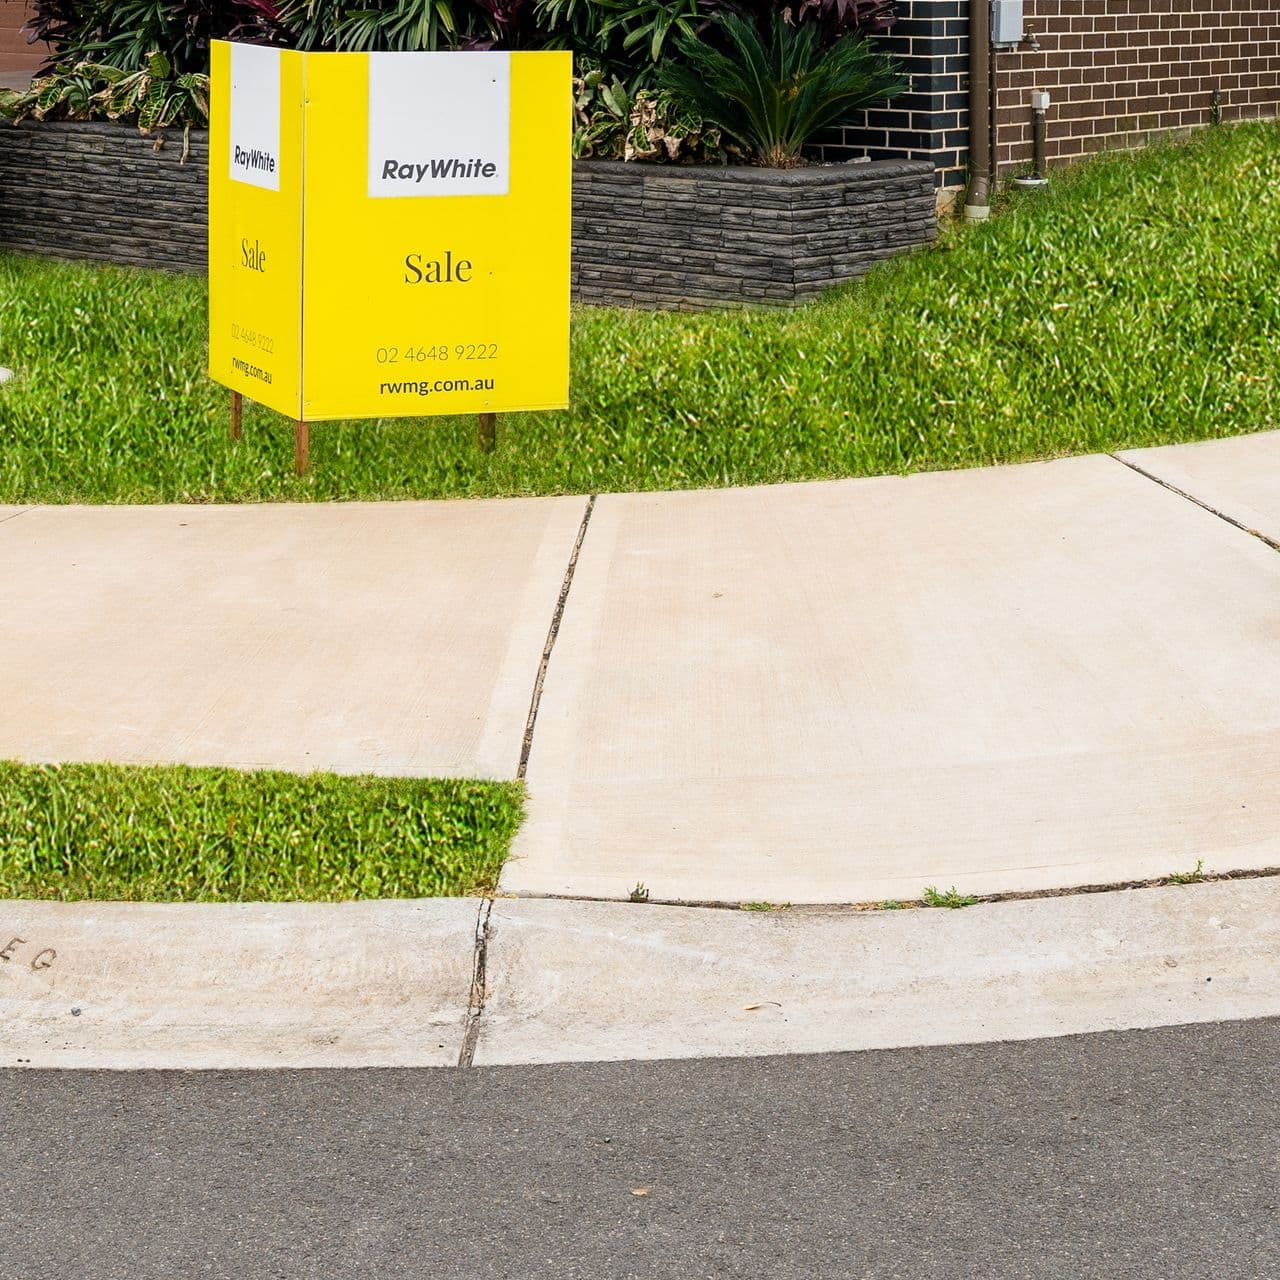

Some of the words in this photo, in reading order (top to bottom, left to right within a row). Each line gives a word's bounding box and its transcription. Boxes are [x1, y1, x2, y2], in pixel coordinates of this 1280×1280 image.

[241, 237, 266, 273] Sale
[404, 250, 473, 284] Sale
[231, 322, 240, 340] 02
[376, 347, 399, 364] 02
[404, 345, 449, 362] 4648
[454, 343, 498, 360] 9222
[232, 357, 272, 385] rwmg.com.au
[380, 378, 495, 397] rwmg.com.au
